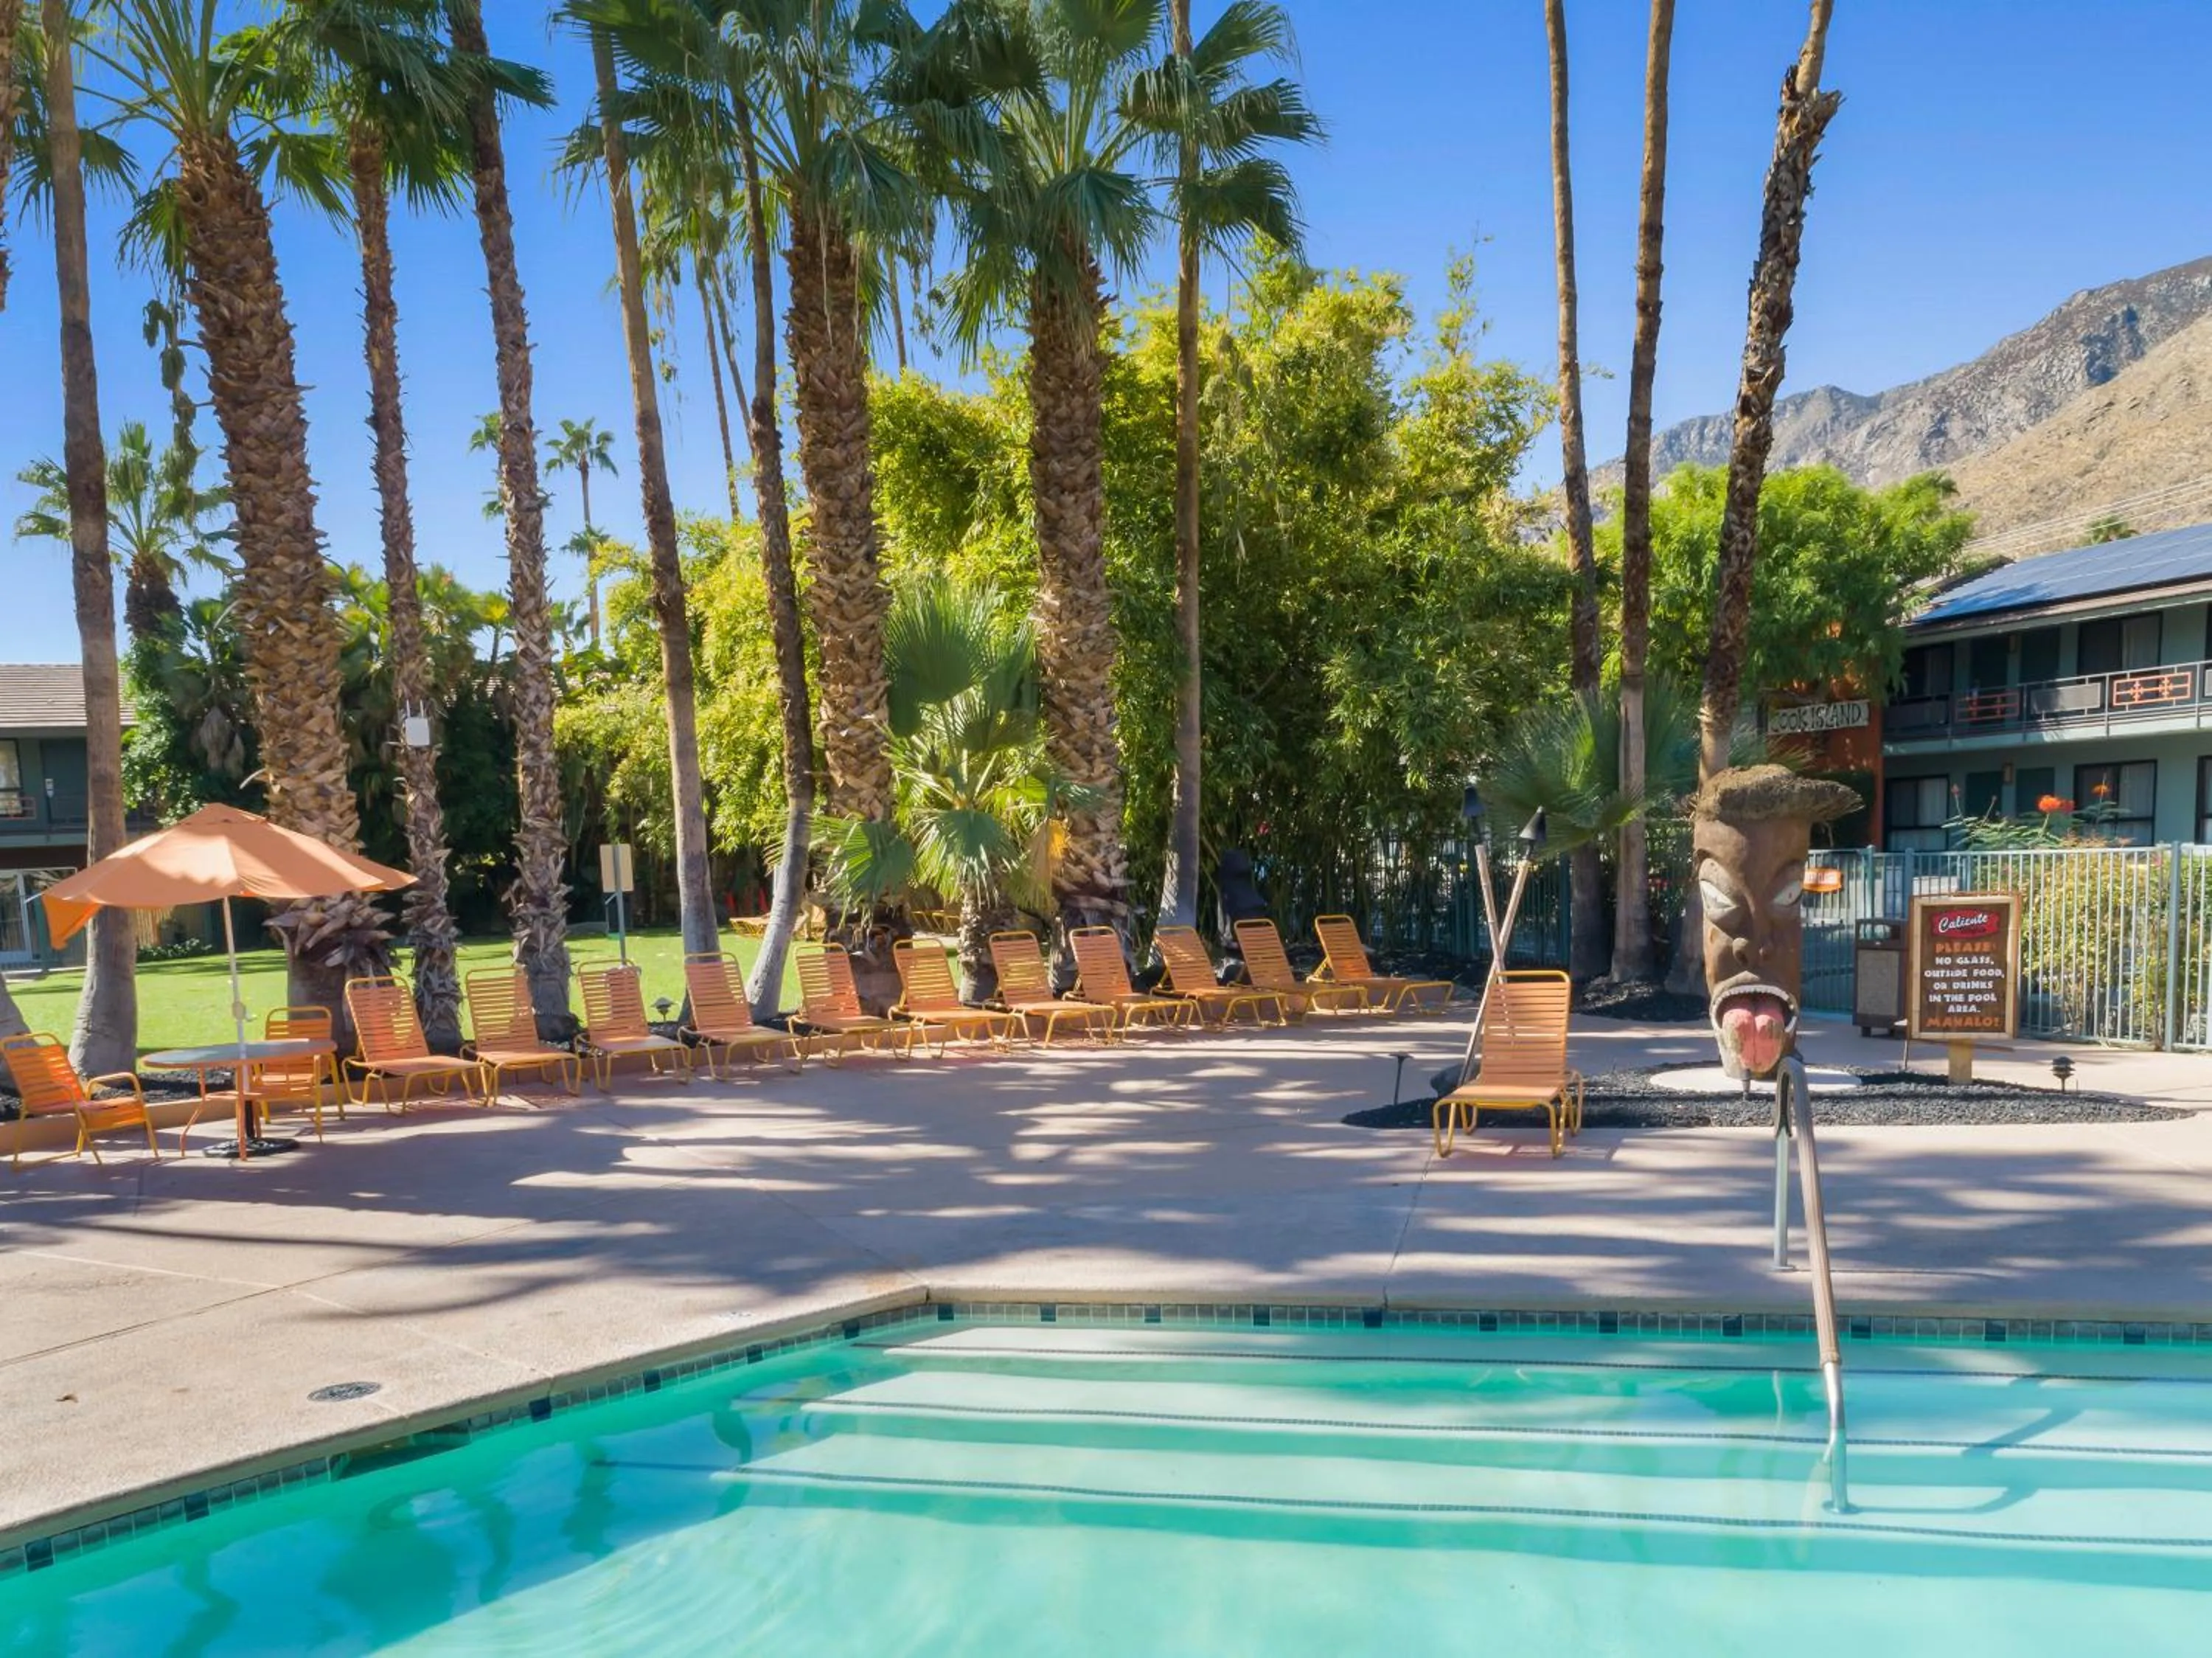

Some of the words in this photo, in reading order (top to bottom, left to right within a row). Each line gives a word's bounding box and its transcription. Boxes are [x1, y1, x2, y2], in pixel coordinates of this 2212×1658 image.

[1938, 913, 1988, 933] Caliente
[1935, 957, 1952, 965] NO
[1924, 970, 1968, 978] OUTSIDE
[1972, 968, 2005, 979] FOOD,
[1933, 982, 1947, 991] OR
[1952, 981, 1994, 990] DRINKS
[1928, 994, 1941, 1002] IN
[1943, 993, 1965, 1002] THE
[1968, 993, 1997, 1002] POOL
